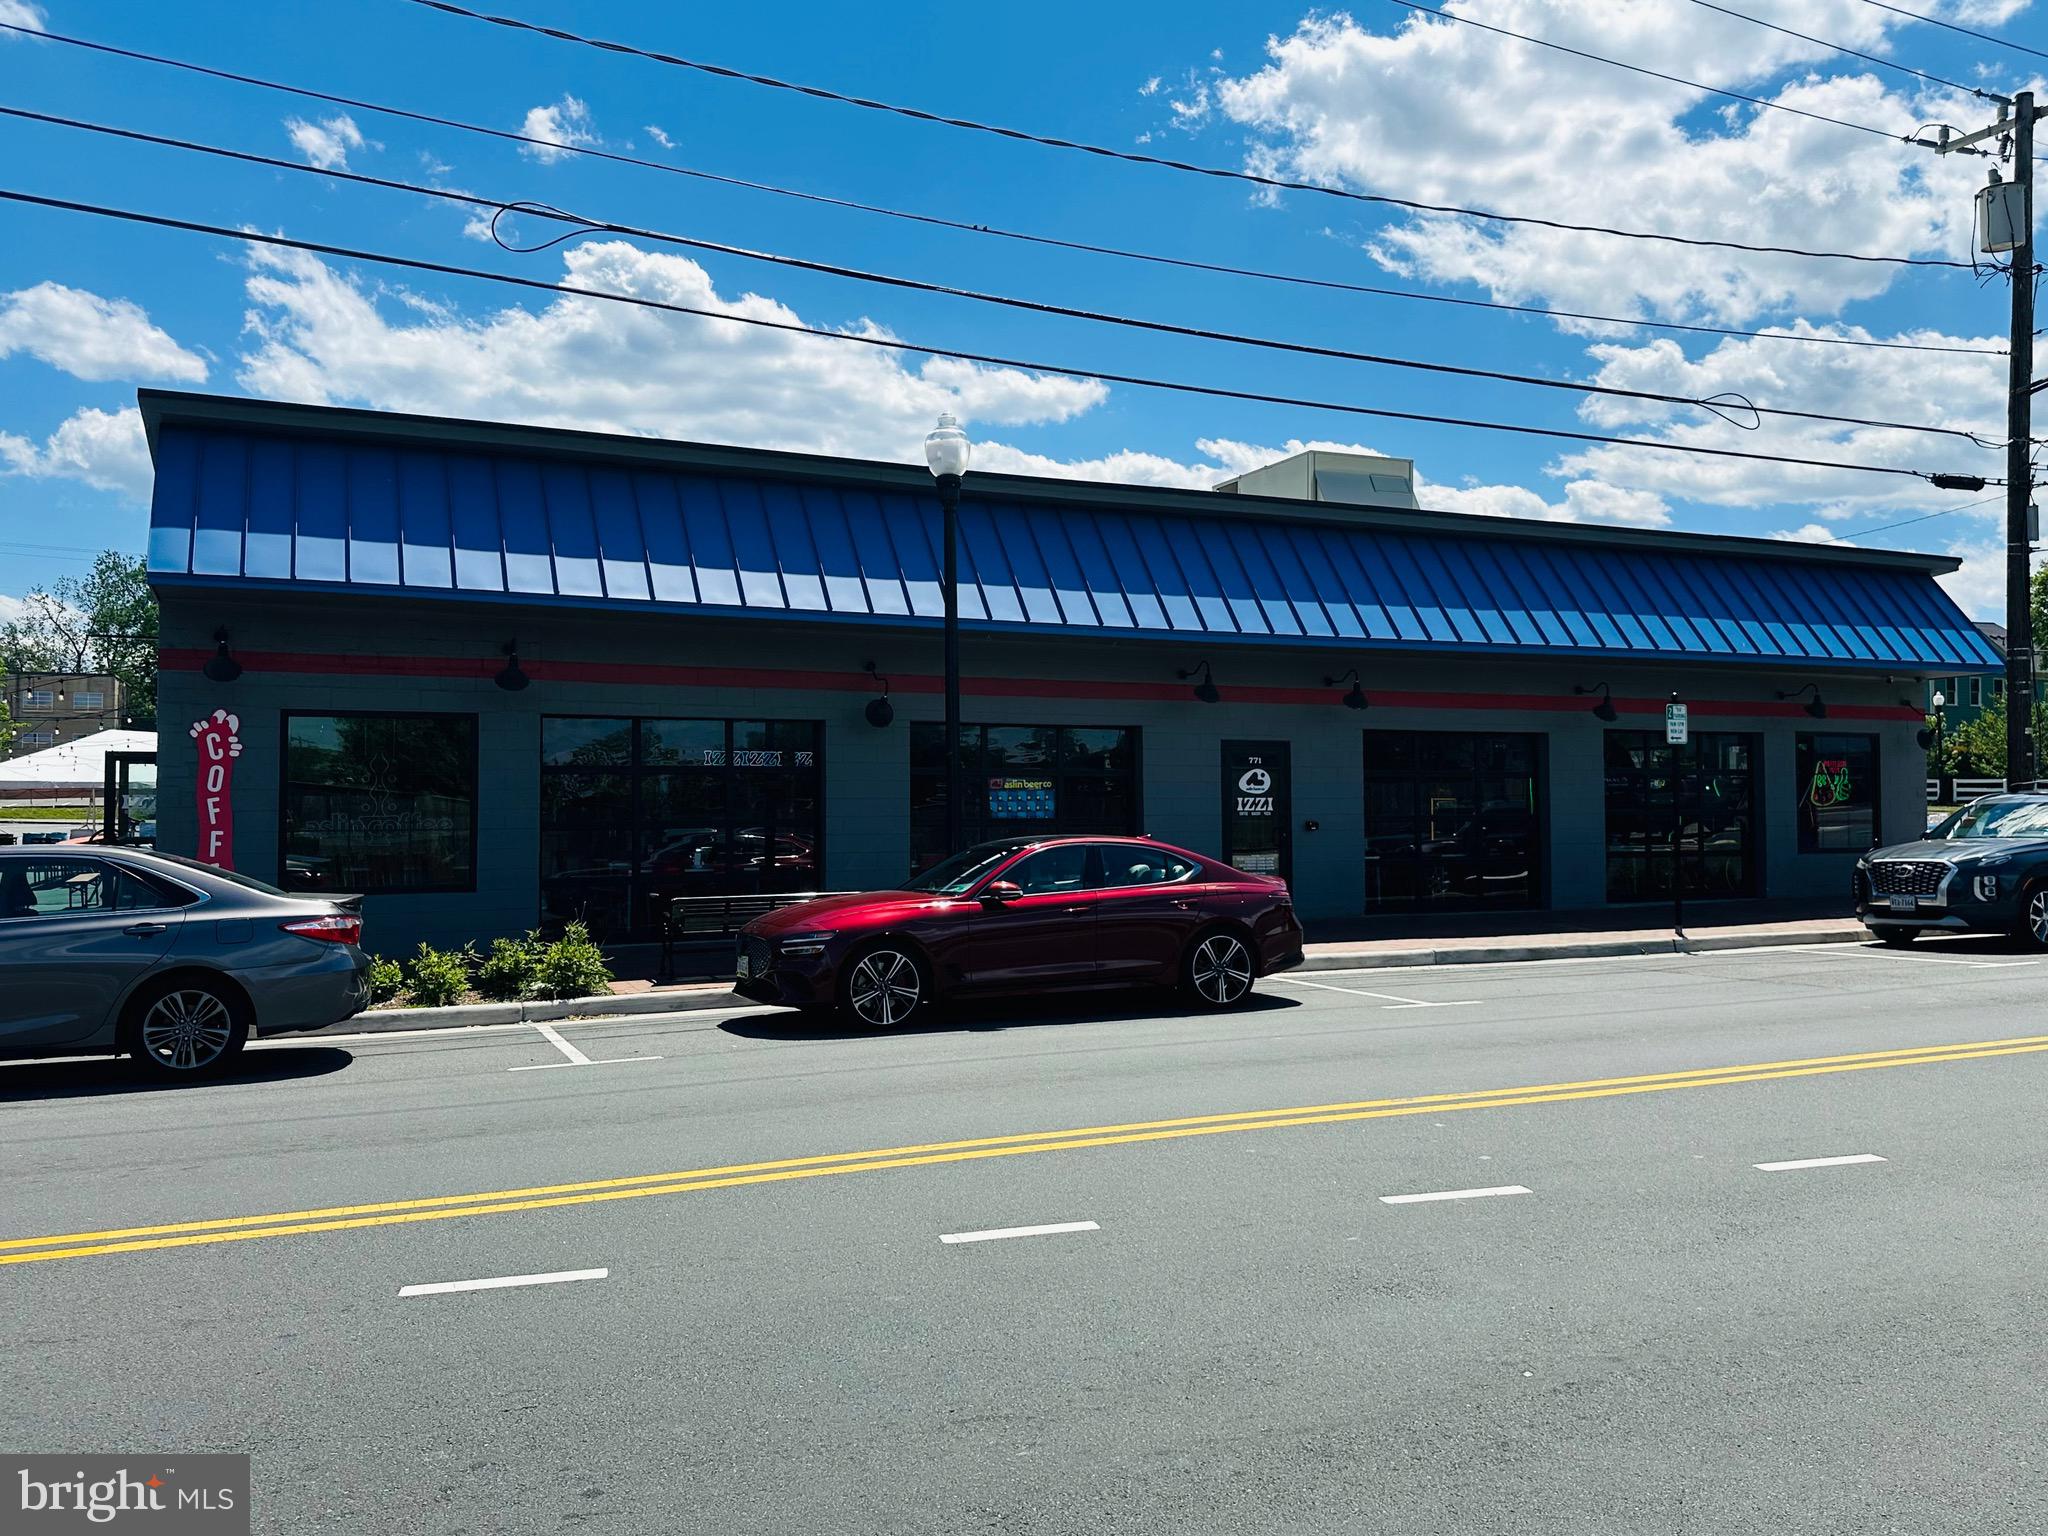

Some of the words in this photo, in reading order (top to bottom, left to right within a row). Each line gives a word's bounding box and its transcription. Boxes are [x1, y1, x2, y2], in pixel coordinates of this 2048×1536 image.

[1248, 756, 1262, 764] 771
[206, 732, 224, 871] COFF
[1236, 797, 1274, 811] IZZI
